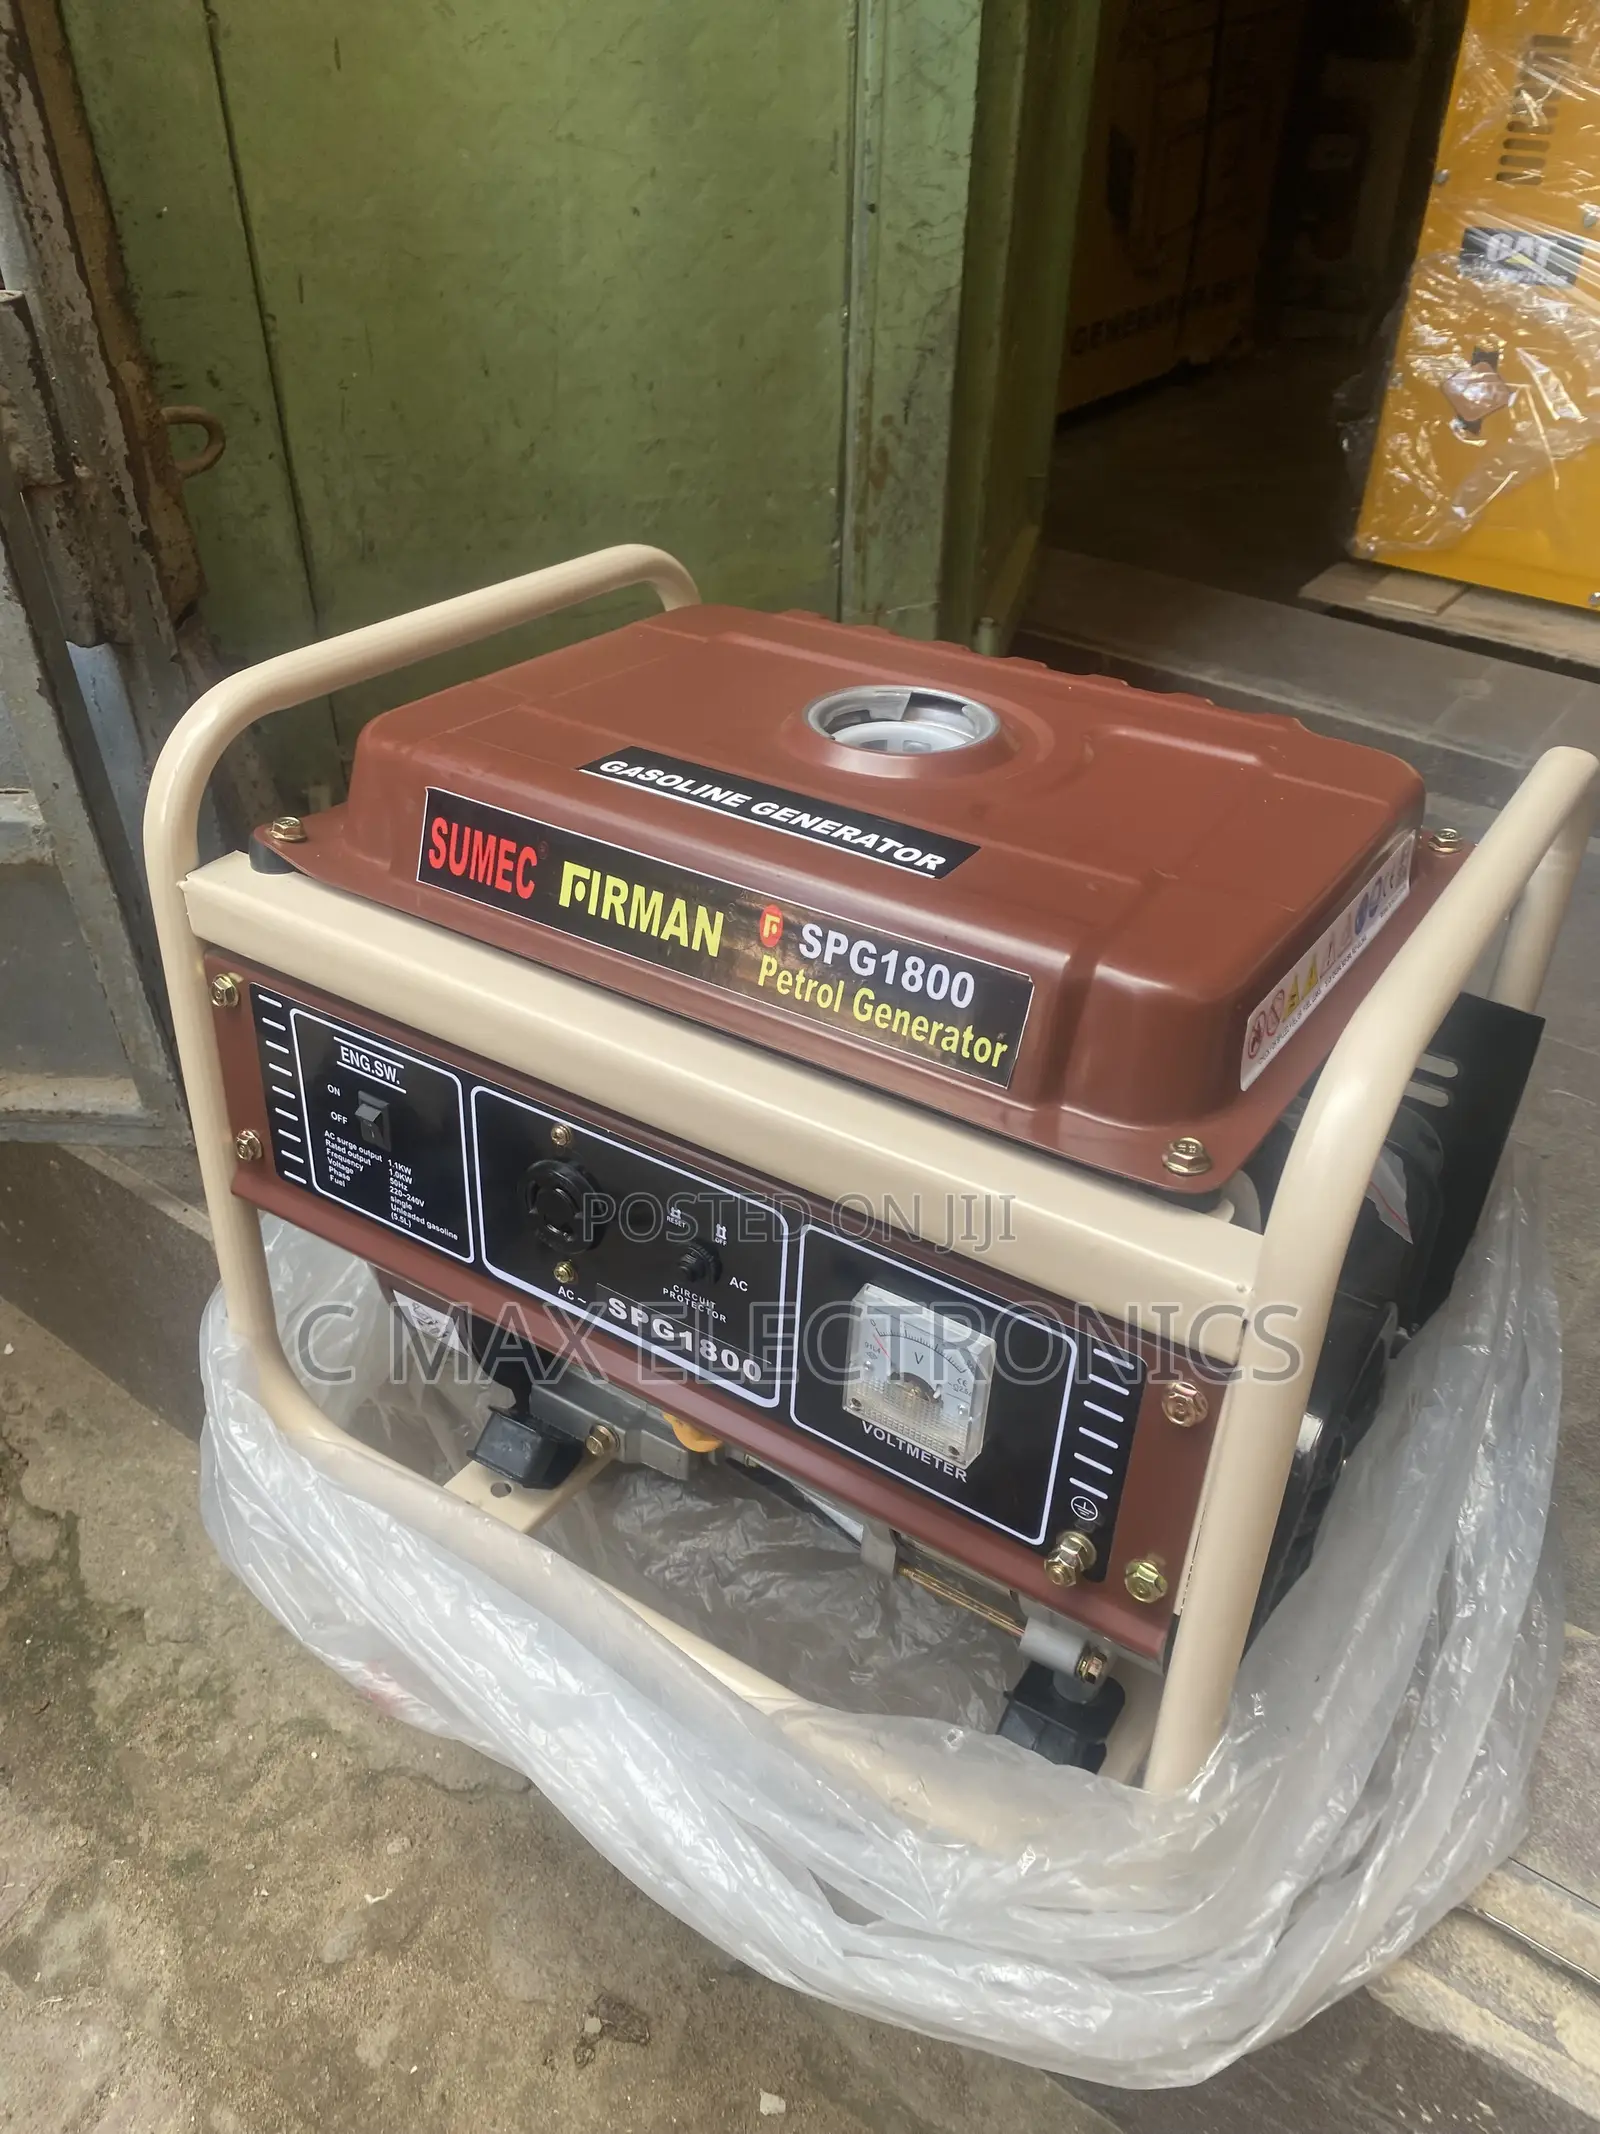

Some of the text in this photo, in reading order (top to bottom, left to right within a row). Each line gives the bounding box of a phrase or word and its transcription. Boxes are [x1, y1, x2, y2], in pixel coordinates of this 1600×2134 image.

[600, 760, 946, 871] GASOLINE GENERATOR
[428, 817, 538, 899] SUMEC
[558, 860, 724, 958] FIRMAN
[799, 923, 975, 1009] SPG1800
[757, 954, 1008, 1068] Petrol Generator
[340, 1045, 400, 1085] ENG.SW.
[327, 1084, 341, 1097] ON
[330, 1111, 348, 1125] OFF
[324, 1130, 383, 1162] AC surge output
[325, 1139, 371, 1166] Rated output
[326, 1148, 364, 1172] Frequency
[327, 1157, 354, 1175] Voltage
[387, 1159, 412, 1175] 1.1KW
[328, 1166, 350, 1181] Phase
[329, 1175, 346, 1187] Fuel
[389, 1178, 408, 1191] 50Hz
[390, 1203, 458, 1240] Unleaded gasoline
[666, 1215, 687, 1229] RESET
[715, 1237, 727, 1246] OFF
[558, 1286, 574, 1301] AC
[729, 1276, 748, 1292] AC
[662, 1287, 727, 1323] PROTECTOR
[673, 1284, 716, 1309] CIRCUIT
[608, 1297, 762, 1382] SPG1800
[914, 1351, 924, 1365] V
[862, 1420, 967, 1483] VOLTMETER
